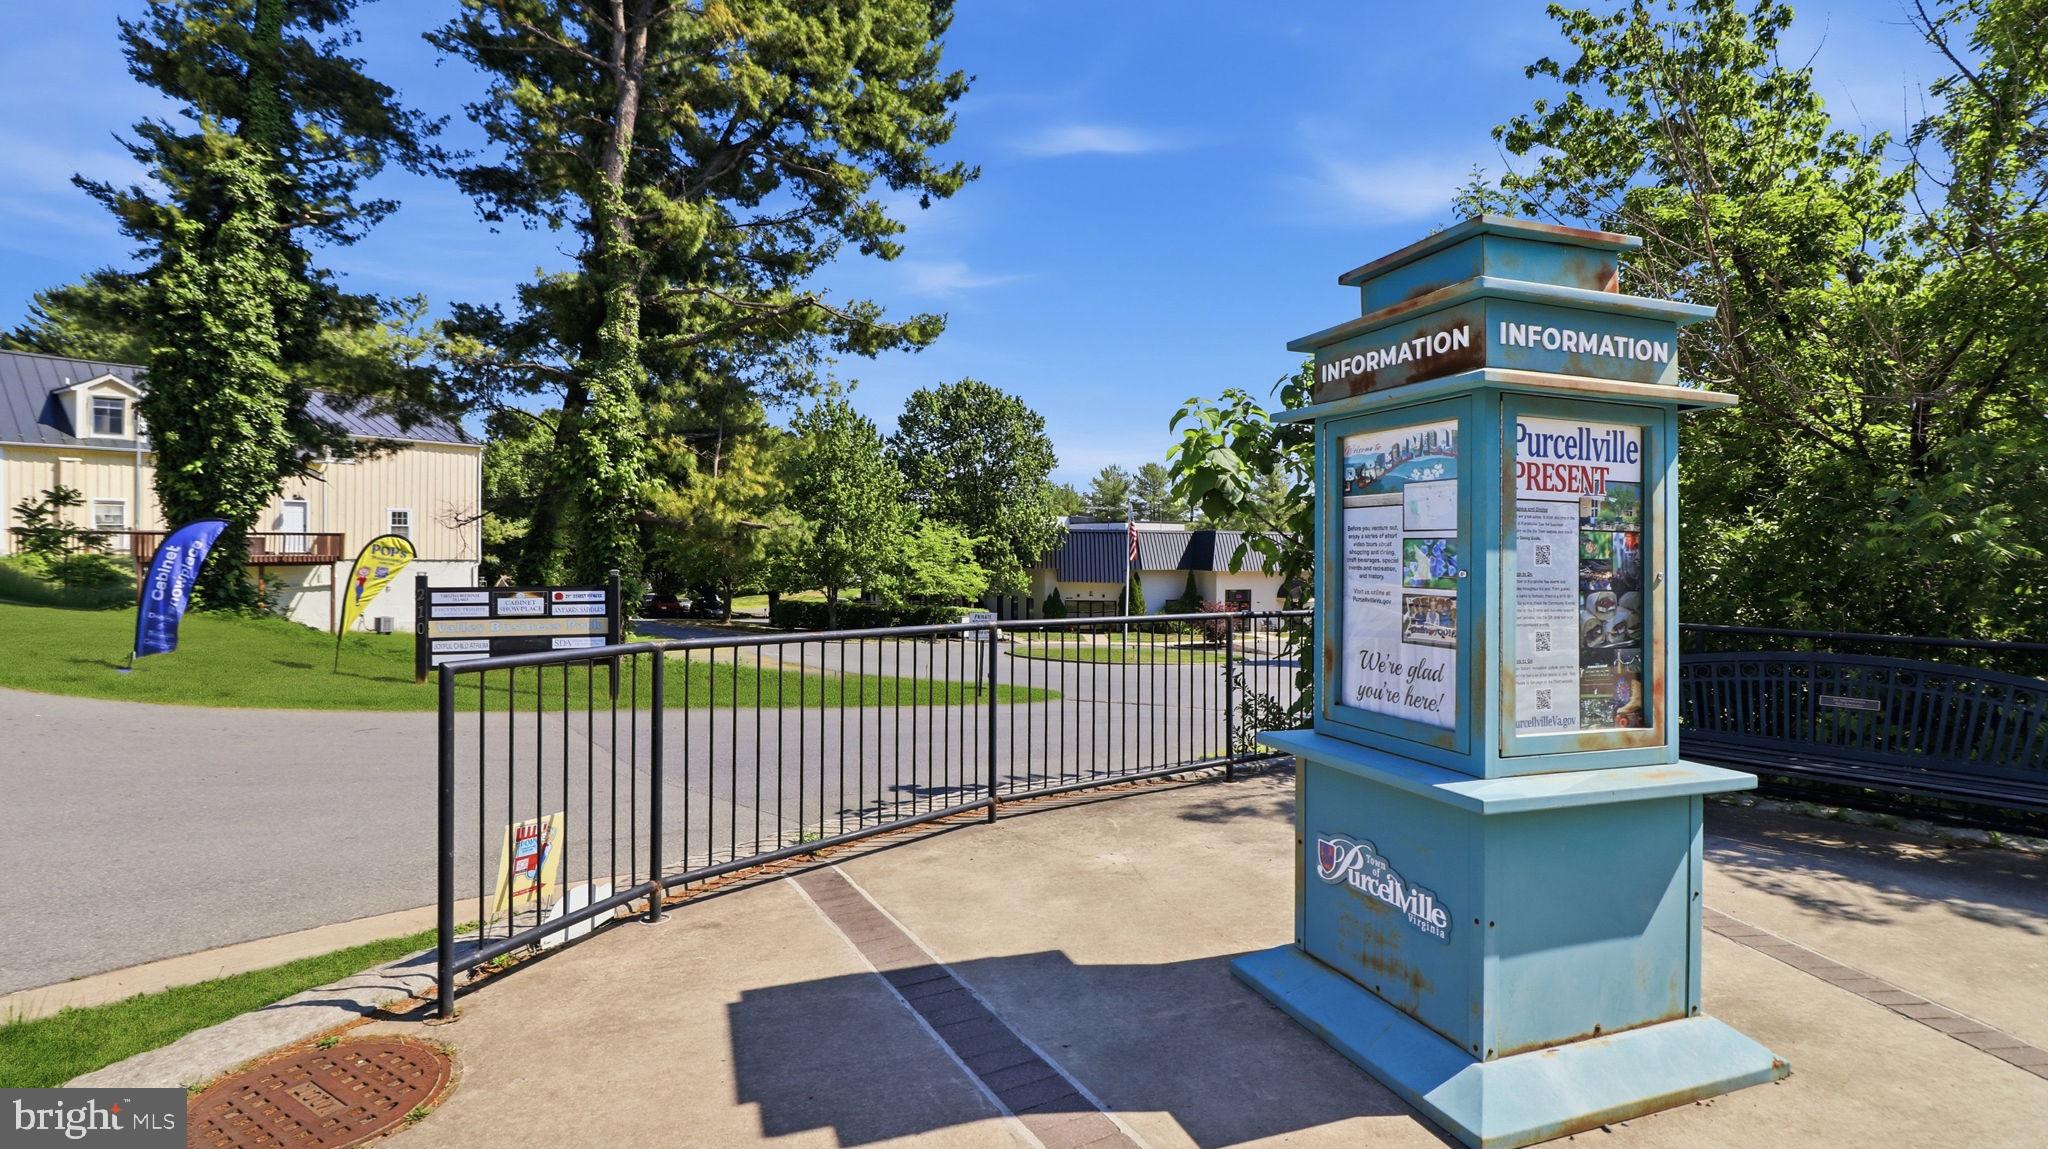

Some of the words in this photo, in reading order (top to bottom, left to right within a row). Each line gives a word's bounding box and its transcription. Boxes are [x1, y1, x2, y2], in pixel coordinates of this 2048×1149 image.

[1322, 325, 1470, 384] INFORMATION
[1500, 322, 1668, 363] INFORMATION
[1517, 423, 1638, 464] Purcellville
[1517, 462, 1609, 494] PRESENT
[151, 545, 181, 601] Cabinet
[1360, 650, 1402, 676] We're
[1407, 658, 1445, 684] glad
[1356, 681, 1400, 704] you're
[1404, 685, 1445, 712] here!
[1516, 716, 1576, 728] urcellvilleVa.gov
[1366, 854, 1386, 870] Town
[1372, 868, 1380, 877] of
[1408, 912, 1445, 939] Virginia
